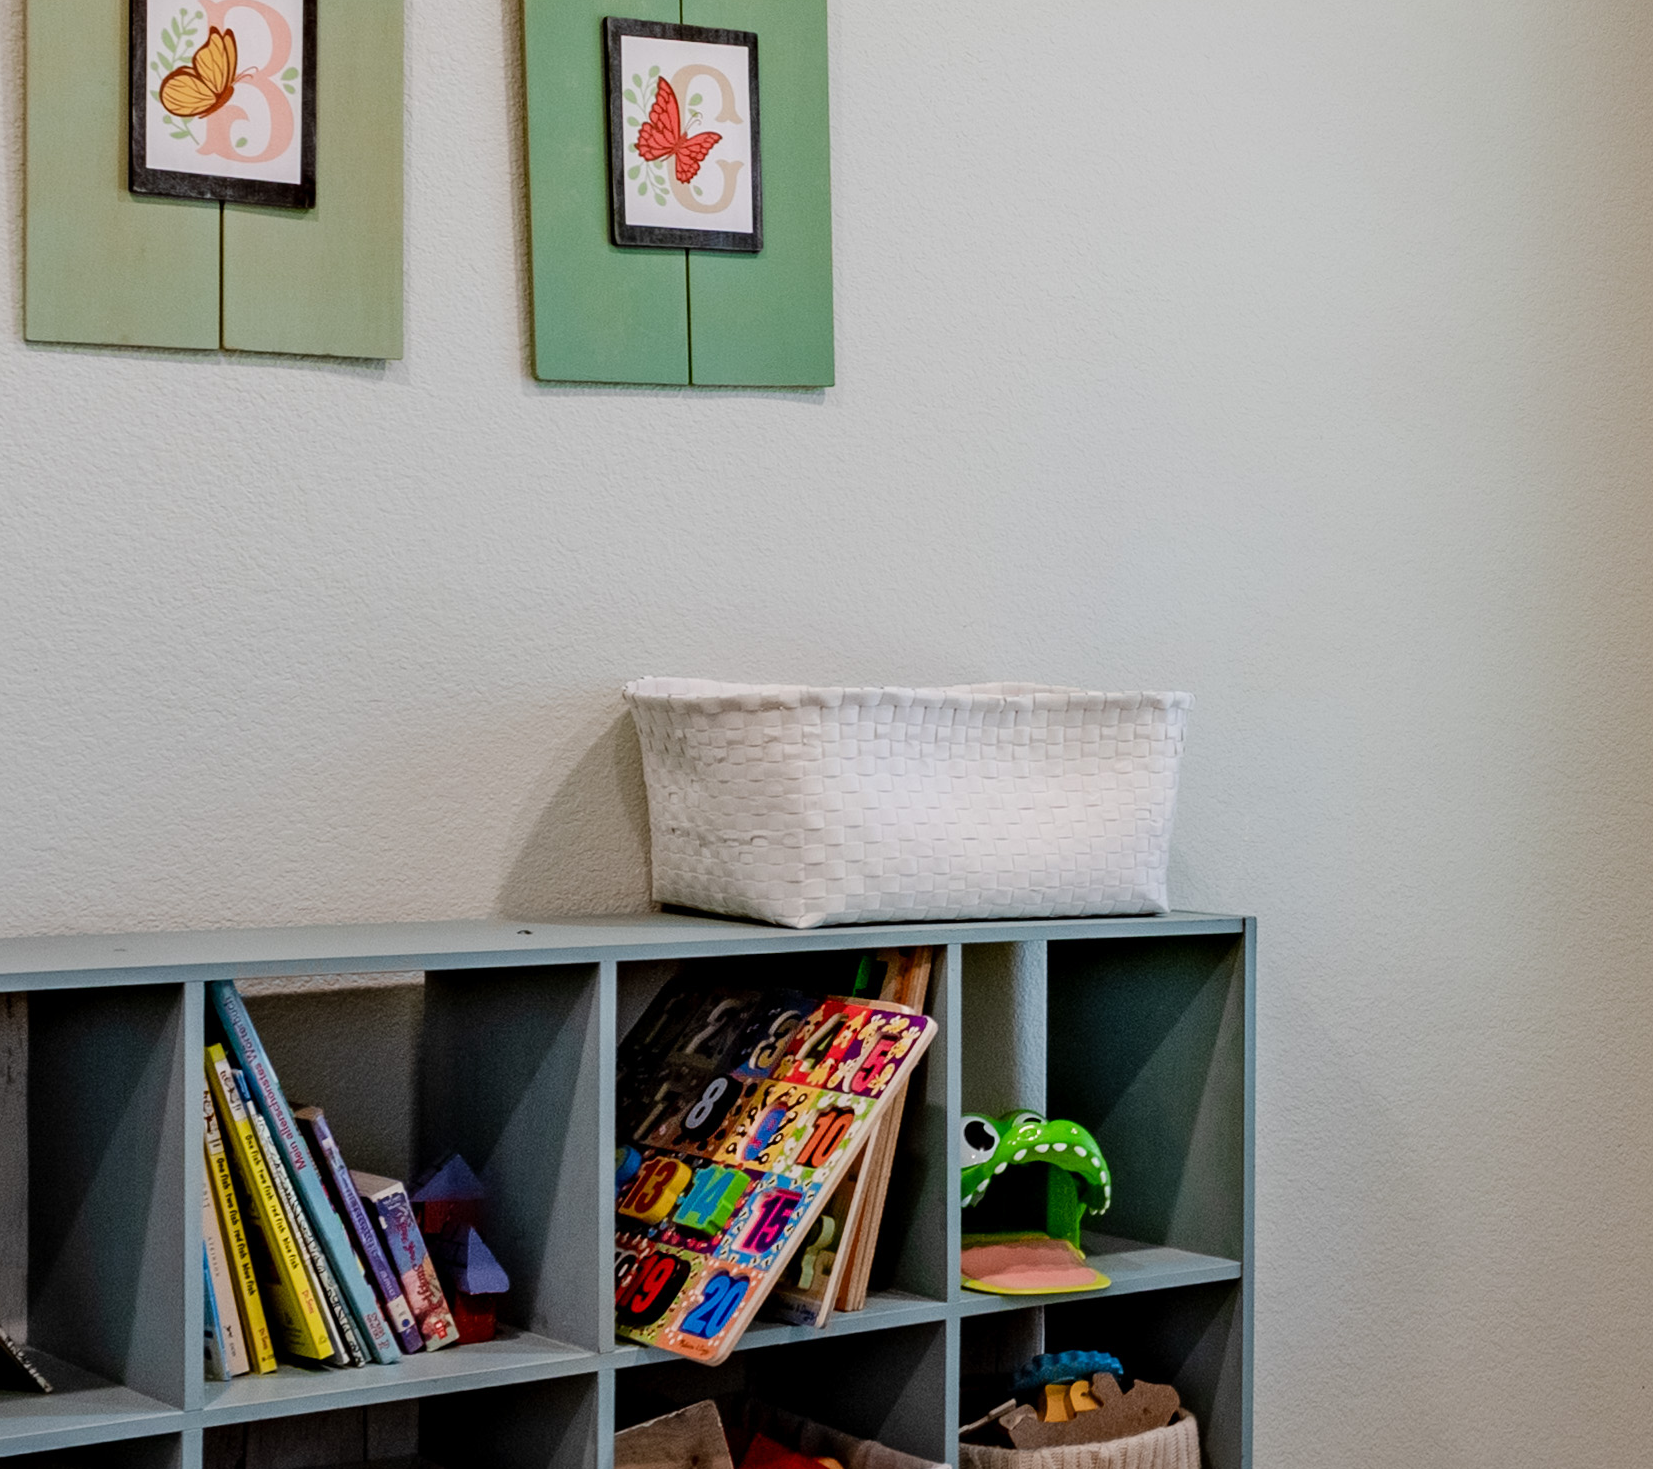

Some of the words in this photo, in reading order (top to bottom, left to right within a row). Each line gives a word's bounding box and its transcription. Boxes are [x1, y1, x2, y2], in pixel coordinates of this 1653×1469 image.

[748, 1009, 803, 1071] 3
[844, 1032, 901, 1093] 5
[685, 1077, 729, 1129] 8
[796, 1108, 855, 1168] 10
[245, 1134, 254, 1150] One
[216, 1157, 226, 1175] One
[250, 1147, 262, 1167] fish
[290, 1142, 307, 1171] Mein
[220, 1174, 231, 1191] fish
[257, 1167, 267, 1185] two
[225, 1191, 234, 1208] two
[261, 1183, 274, 1204] fish
[270, 1204, 281, 1218] red
[622, 1159, 679, 1214] 13
[677, 1165, 737, 1226] 14
[742, 1193, 802, 1254] 15
[228, 1207, 240, 1227] fish
[275, 1215, 286, 1235] fish
[233, 1228, 243, 1245] red
[283, 1236, 294, 1254] blue
[237, 1241, 248, 1261] fish
[287, 1251, 298, 1271] fish
[241, 1261, 253, 1279] blue
[246, 1277, 259, 1297] fish
[620, 1254, 677, 1314] 19
[680, 1273, 750, 1339] 20
